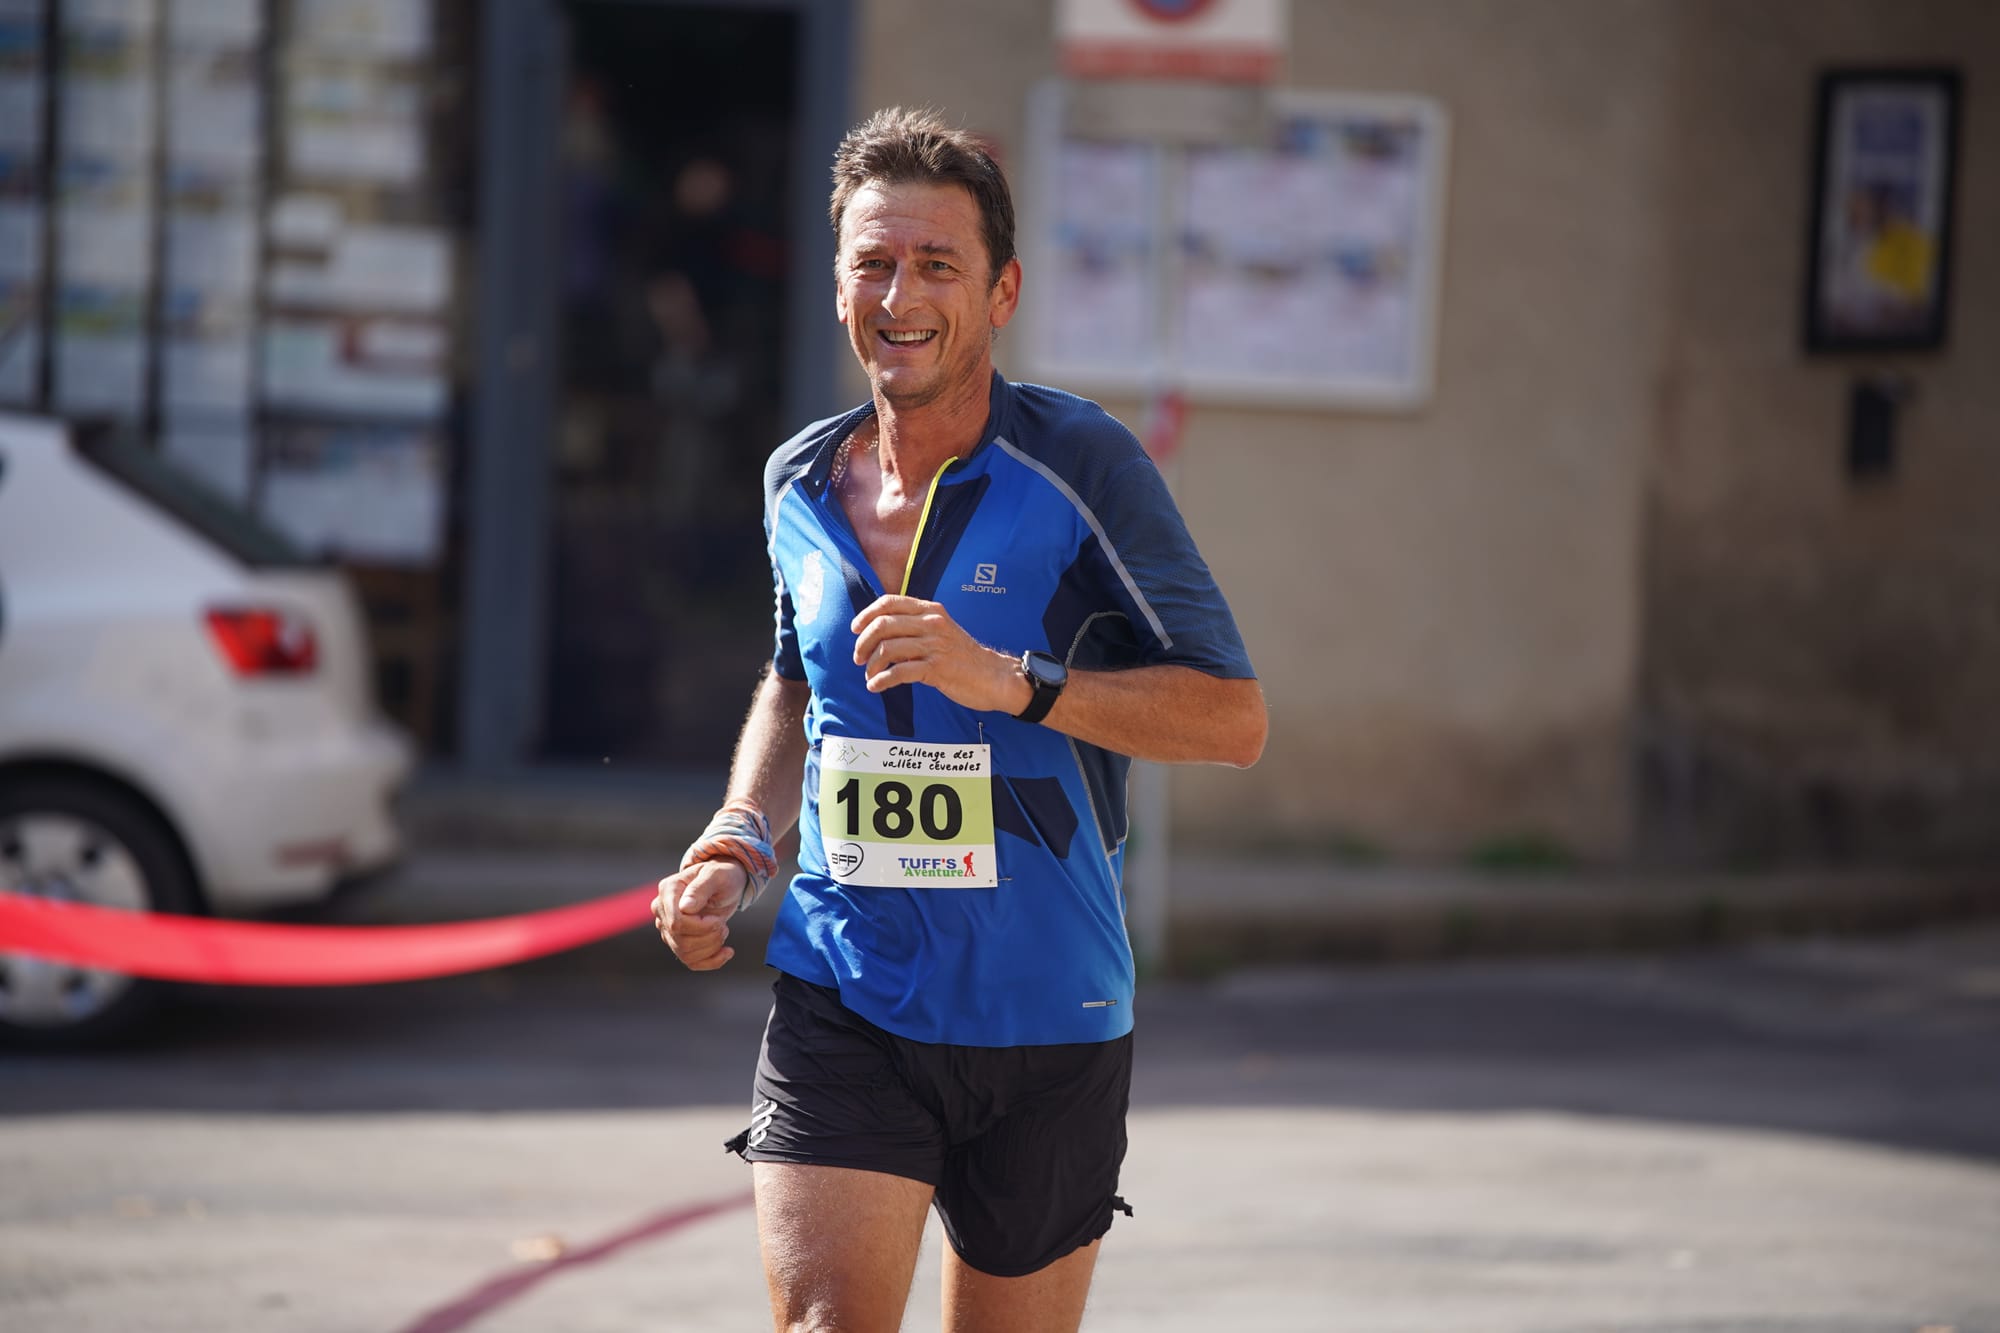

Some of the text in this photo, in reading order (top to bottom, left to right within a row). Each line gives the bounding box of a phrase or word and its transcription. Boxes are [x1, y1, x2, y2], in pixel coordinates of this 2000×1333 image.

[961, 584, 1006, 594] salomon
[888, 746, 974, 762] Challenge des
[882, 759, 981, 771] vallées cévenoles
[837, 778, 962, 840] 180
[898, 857, 957, 869] TUFF'S
[904, 866, 964, 877] Aventure
